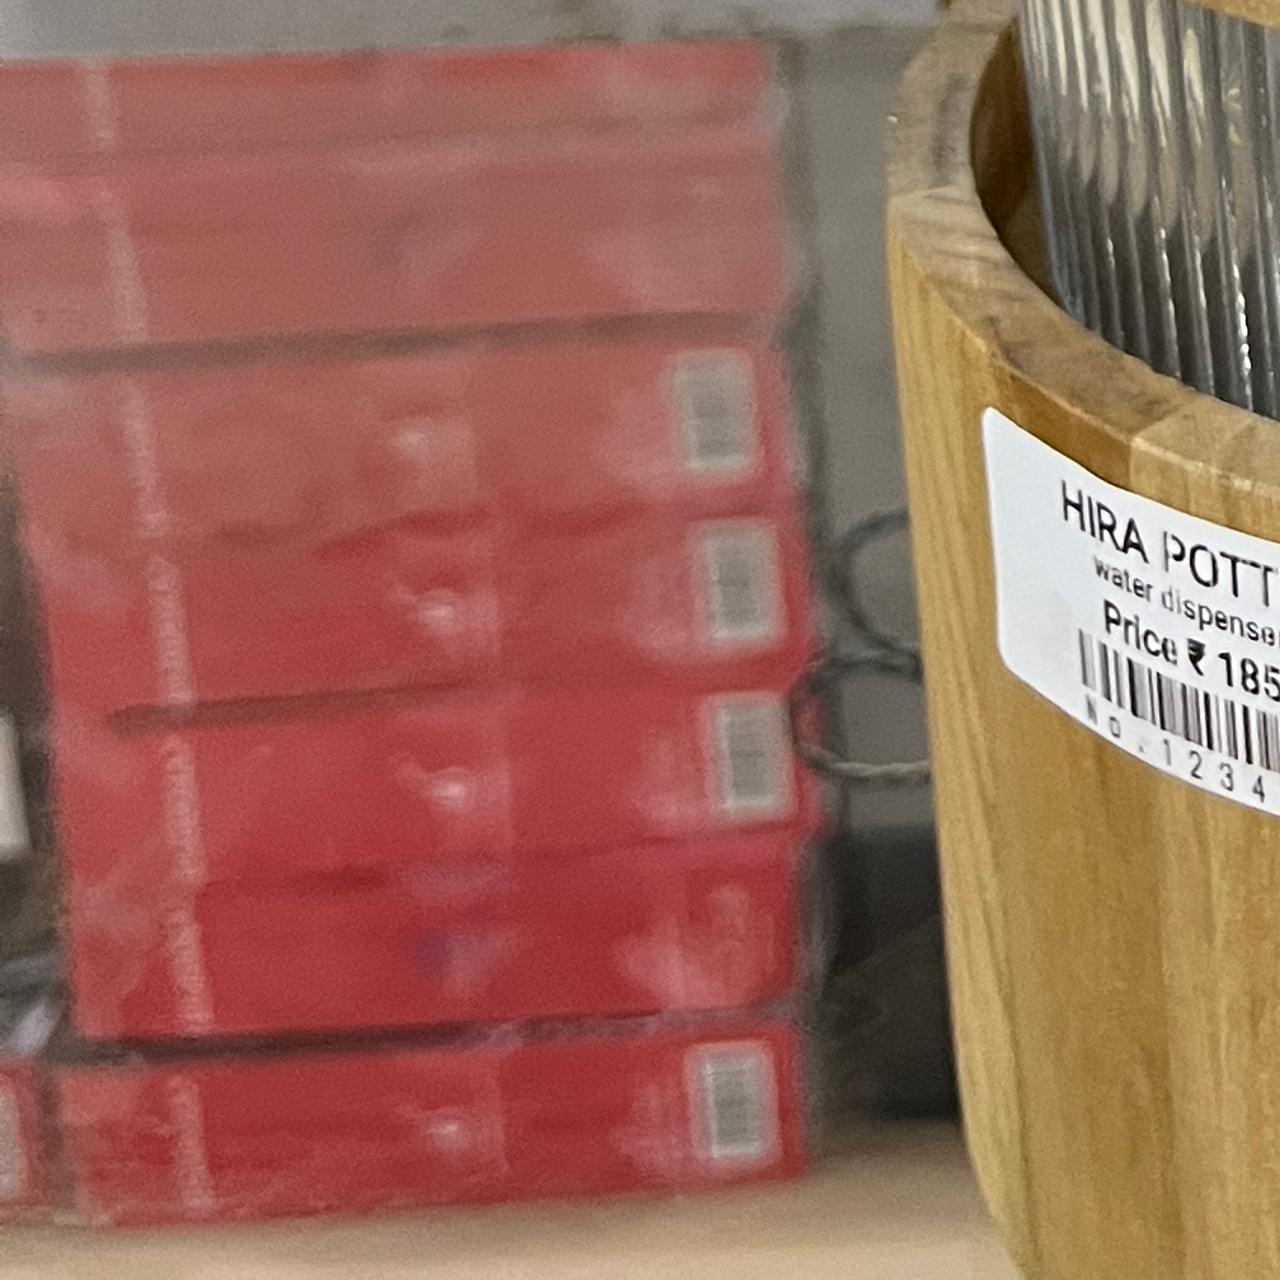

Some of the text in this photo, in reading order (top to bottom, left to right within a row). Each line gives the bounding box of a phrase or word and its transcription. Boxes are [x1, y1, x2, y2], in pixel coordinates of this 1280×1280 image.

[1061, 479, 1150, 564] HIRA
[1093, 554, 1154, 604] water
[1102, 598, 1178, 666] Price
